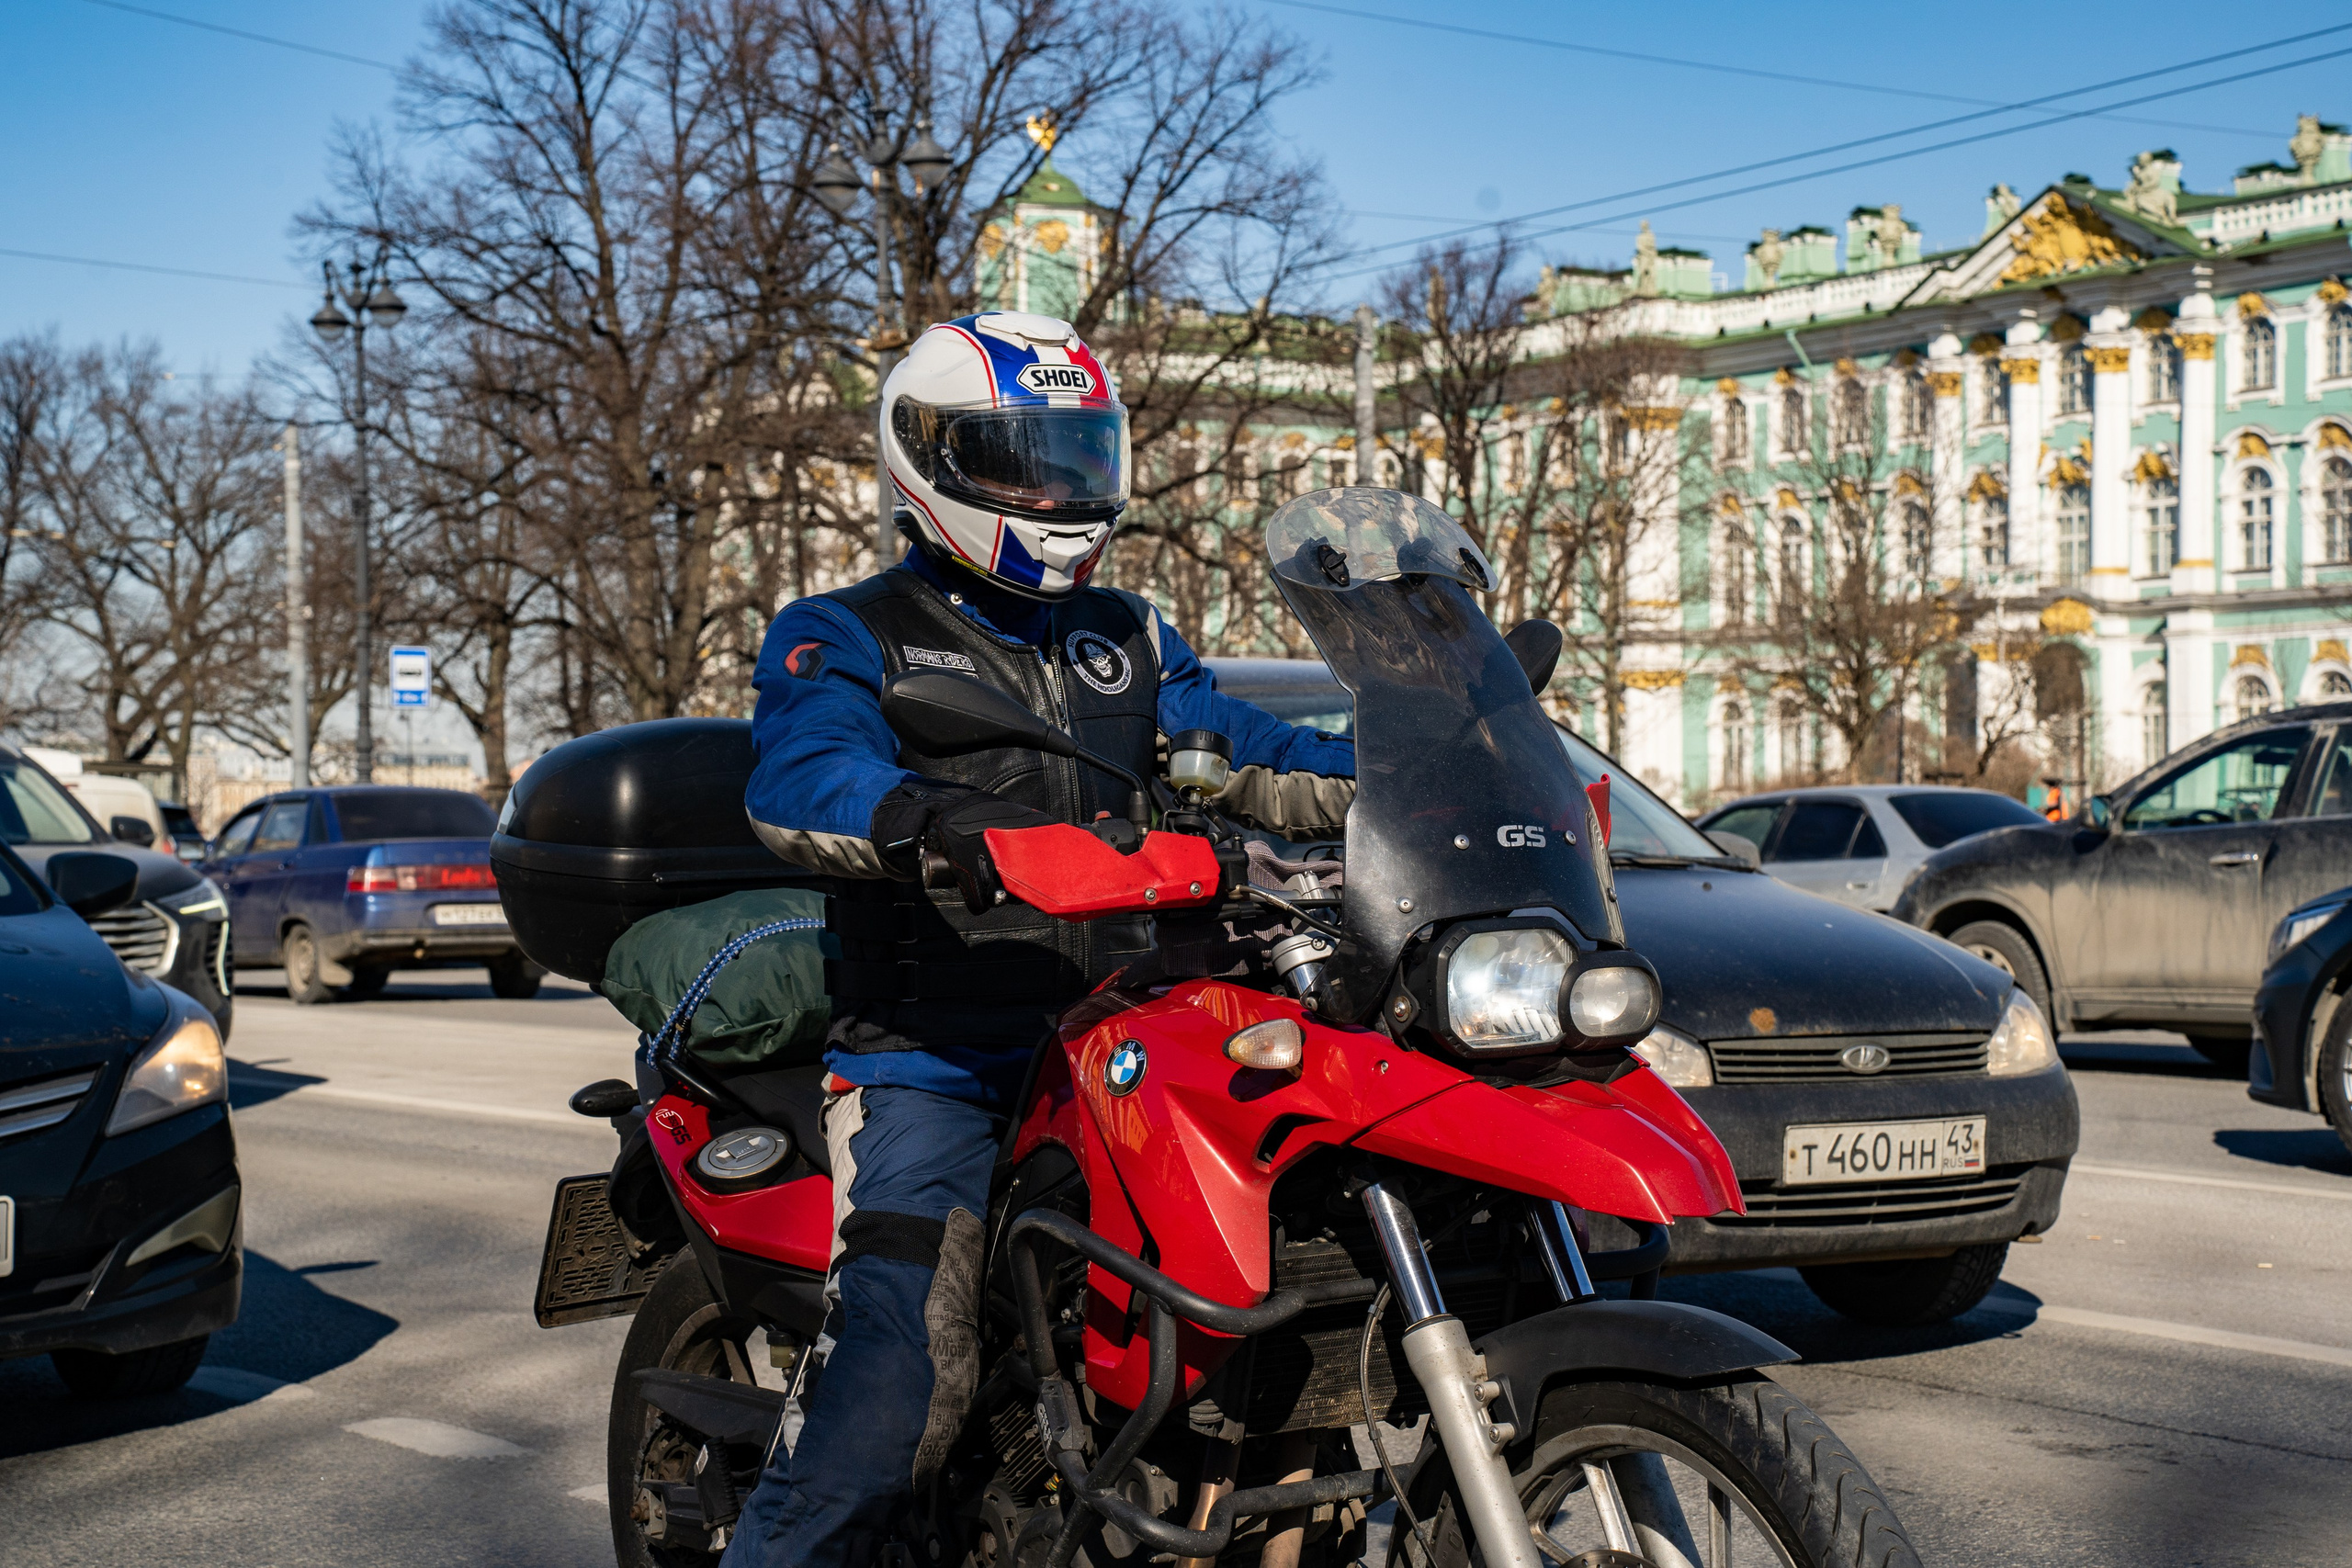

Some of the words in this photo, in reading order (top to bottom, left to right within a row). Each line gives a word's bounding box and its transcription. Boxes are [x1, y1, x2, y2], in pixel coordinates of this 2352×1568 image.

[1031, 369, 1088, 389] SHOEI
[1068, 631, 1088, 649] SUPPORT
[1090, 633, 1108, 645] CLUB
[1084, 672, 1097, 687] THE
[1497, 825, 1546, 848] GS
[1114, 1042, 1145, 1062] BMW
[671, 1124, 692, 1145] GS
[1947, 1123, 1973, 1156] 43
[1943, 1156, 1963, 1168] RUS
